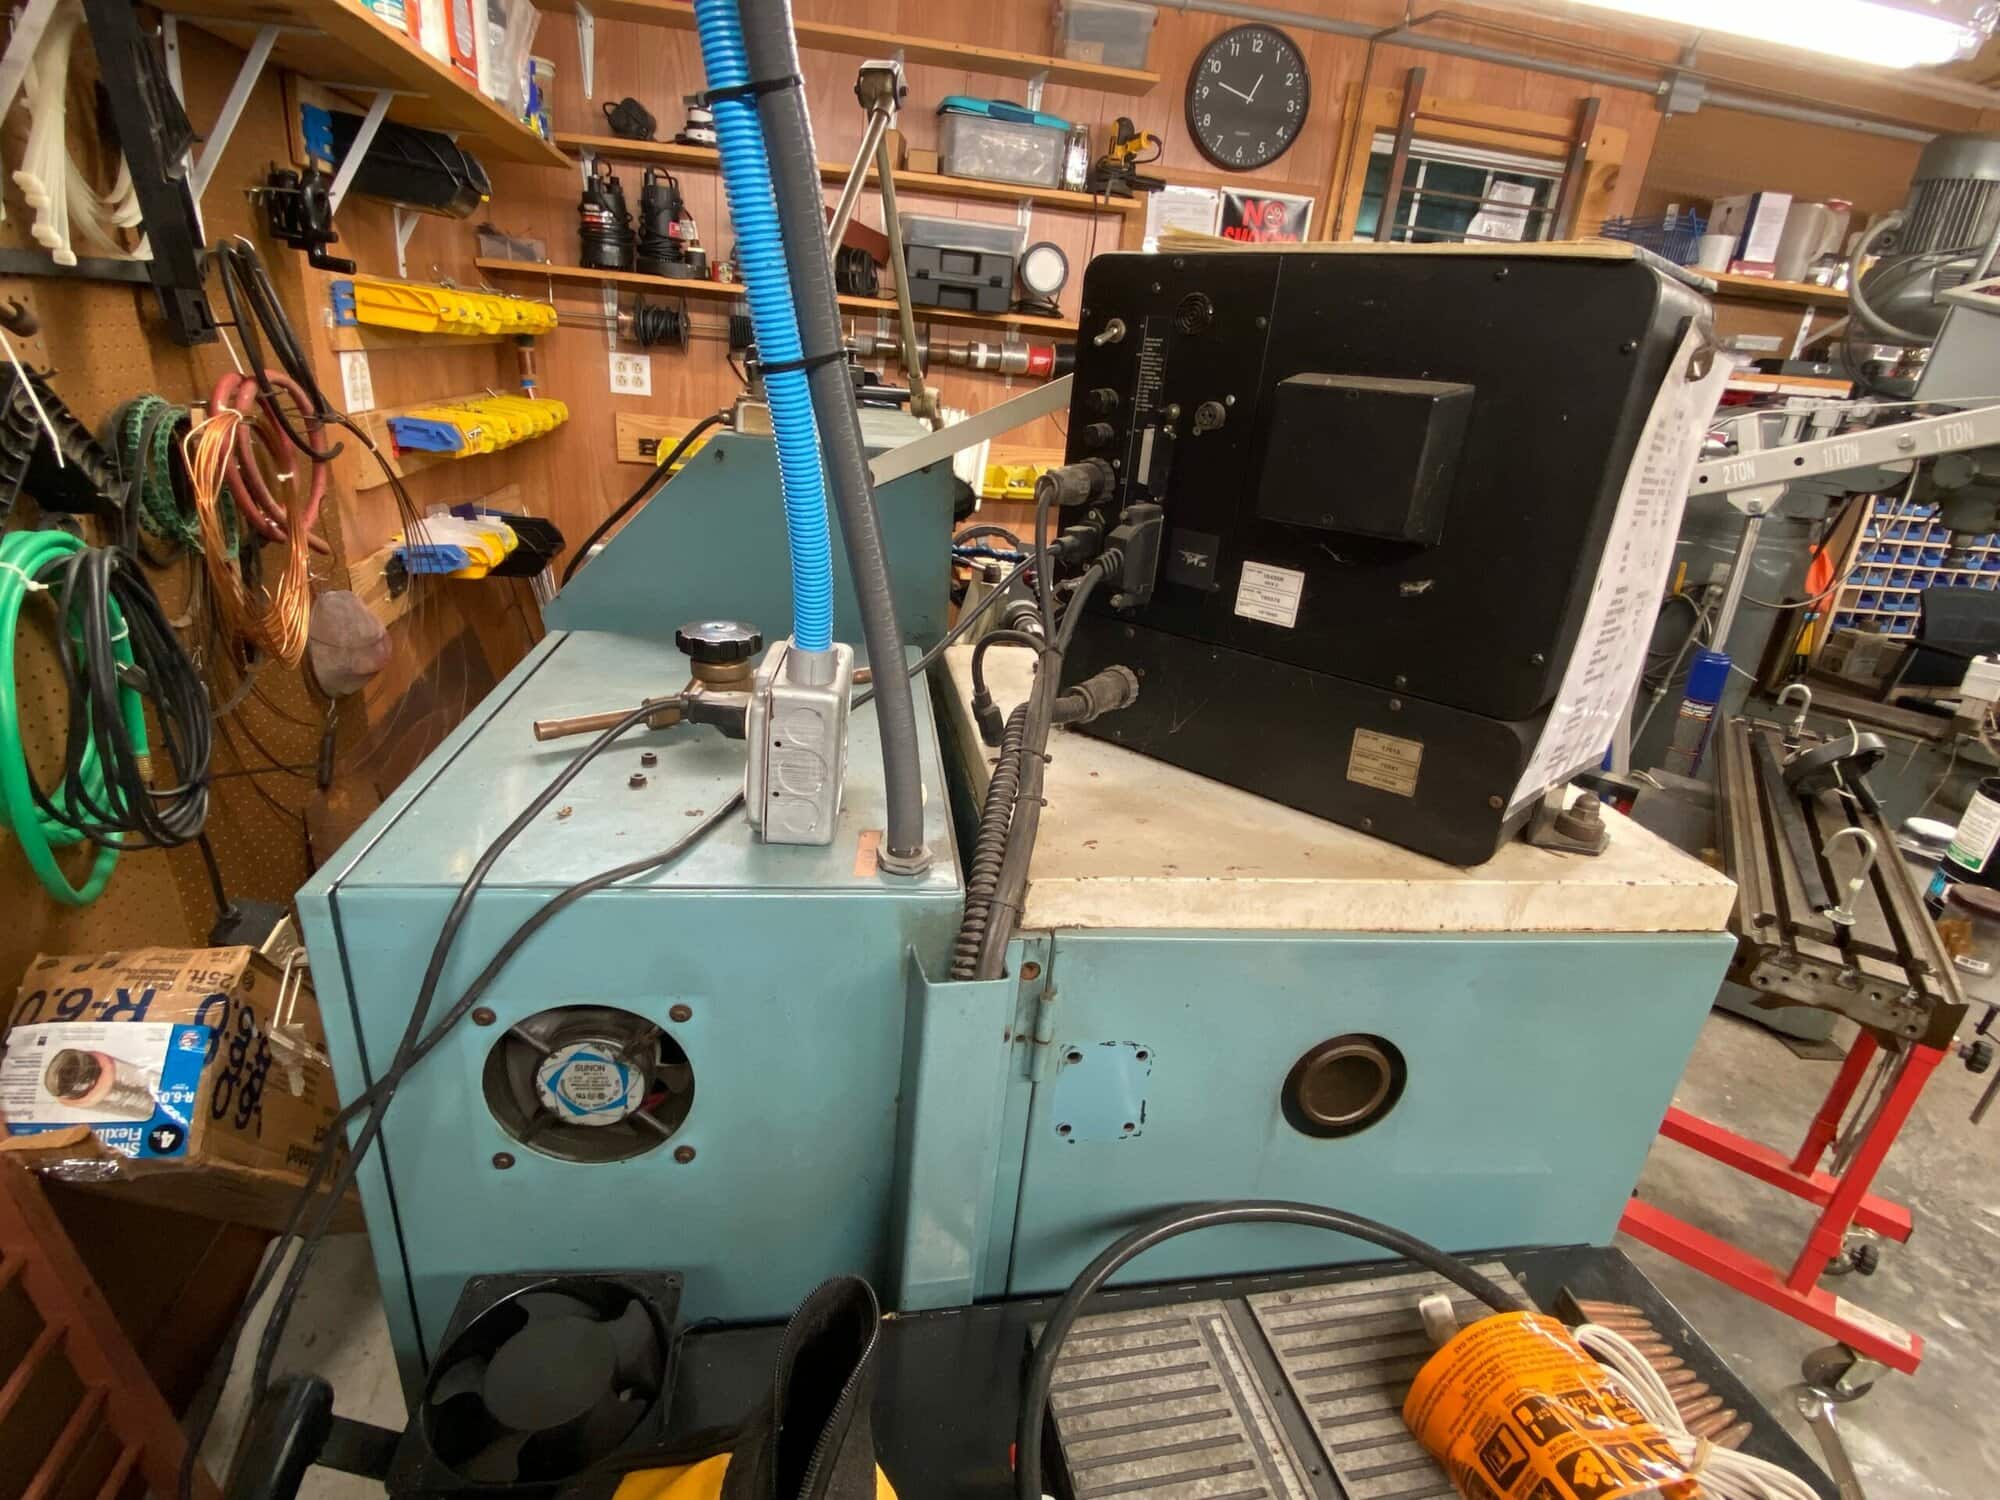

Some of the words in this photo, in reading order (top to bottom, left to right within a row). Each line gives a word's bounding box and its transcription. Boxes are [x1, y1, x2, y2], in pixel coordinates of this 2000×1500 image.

[1231, 43, 1240, 56] 11
[1252, 39, 1263, 53] 12
[1276, 50, 1281, 64] 1
[1210, 60, 1221, 73] 10
[1285, 73, 1294, 86] 2
[1202, 86, 1209, 99] 9
[1287, 100, 1295, 112] 3
[1203, 113, 1211, 126] 8
[1276, 126, 1284, 137] 4
[1215, 135, 1224, 148] 7
[1258, 142, 1266, 154] 5
[1236, 145, 1242, 158] 6
[1242, 199, 1286, 227] NO
[160, 1131, 176, 1149] 4
